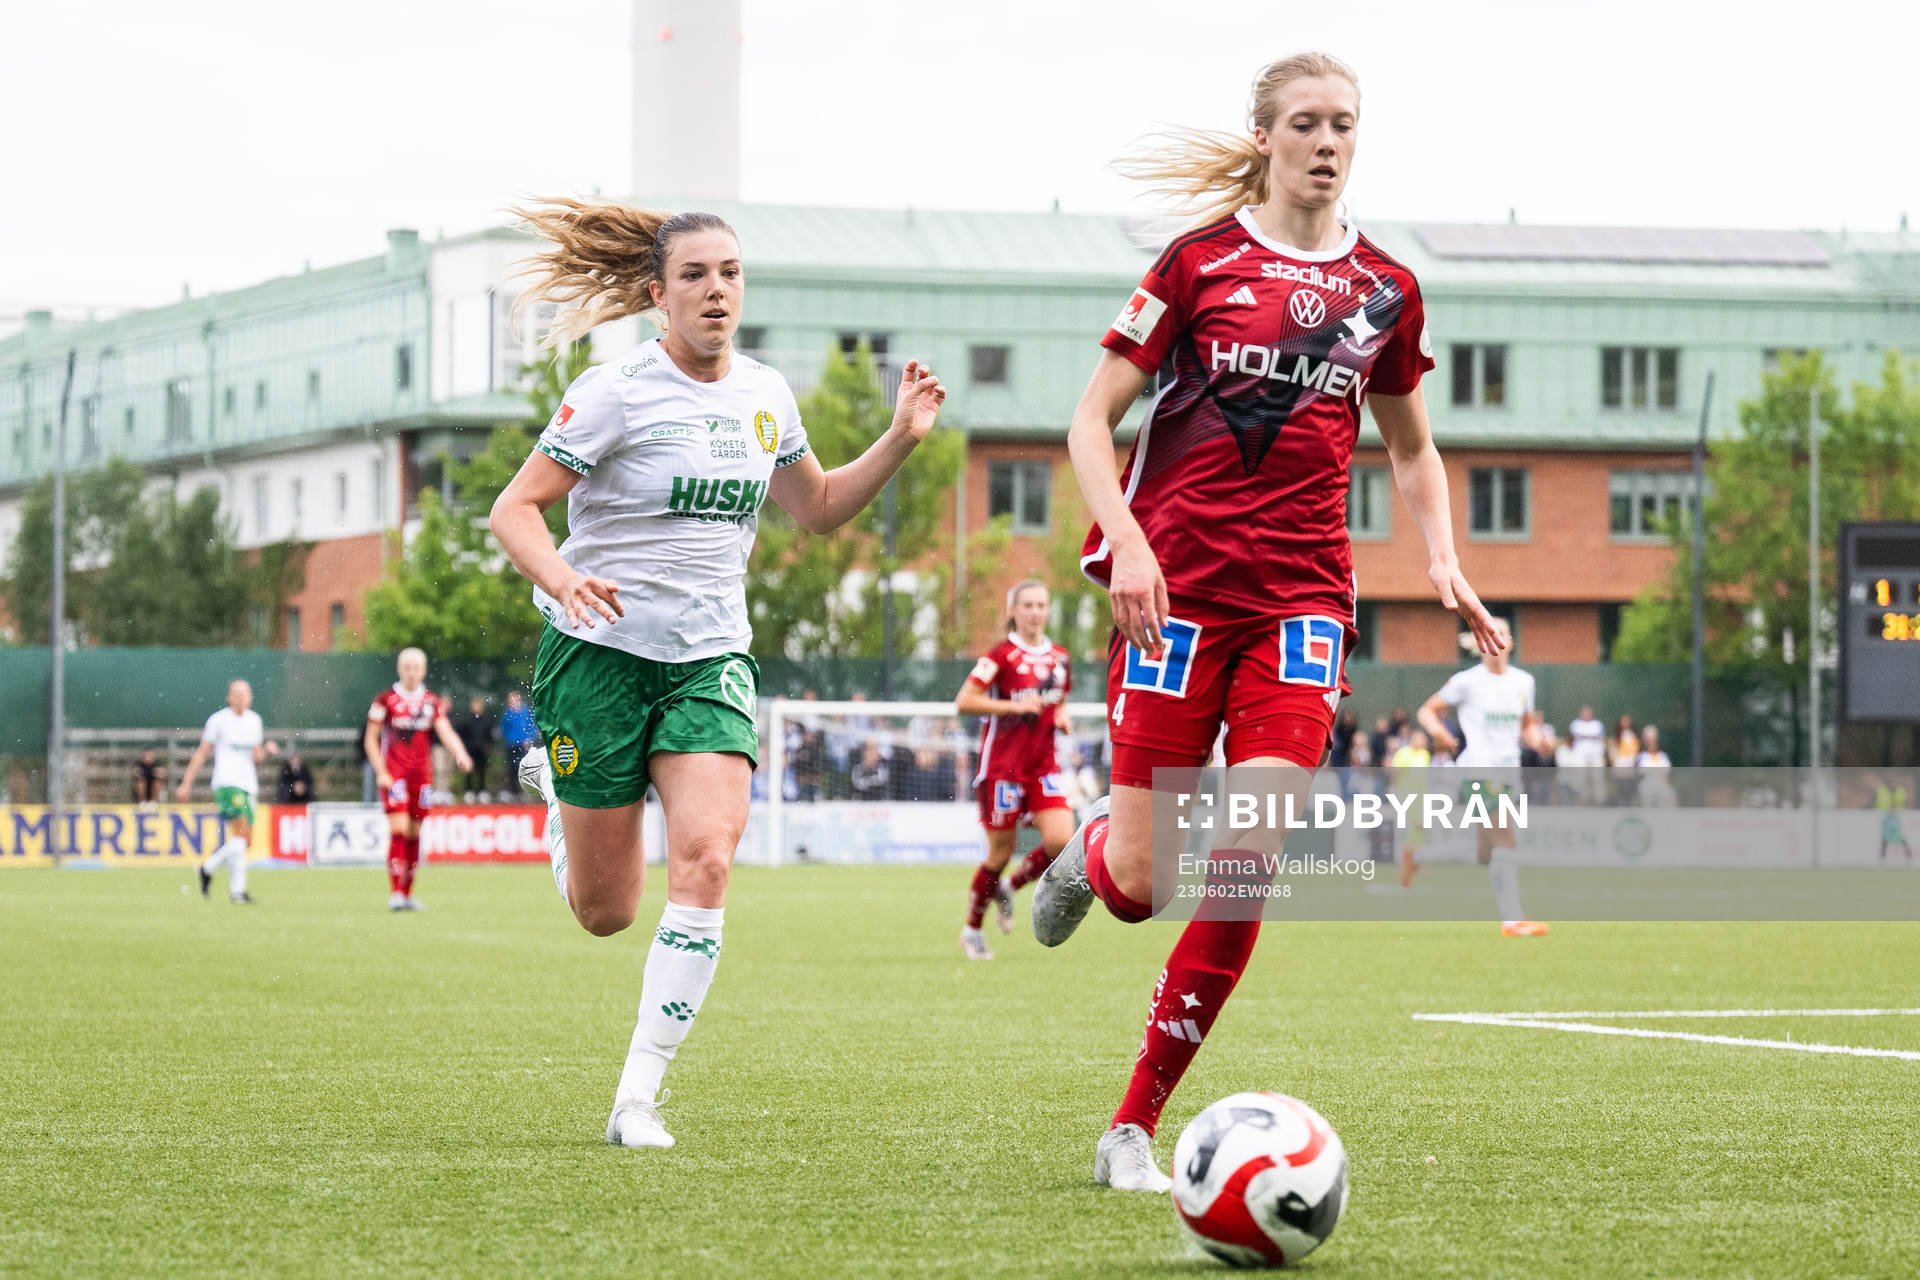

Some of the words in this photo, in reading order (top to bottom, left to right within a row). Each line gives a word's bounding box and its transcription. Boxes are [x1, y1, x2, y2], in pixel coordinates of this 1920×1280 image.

[1261, 260, 1351, 297] stadium
[1211, 339, 1369, 406] HOLMEN
[651, 428, 686, 438] CRAFT
[1112, 692, 1126, 726] 4
